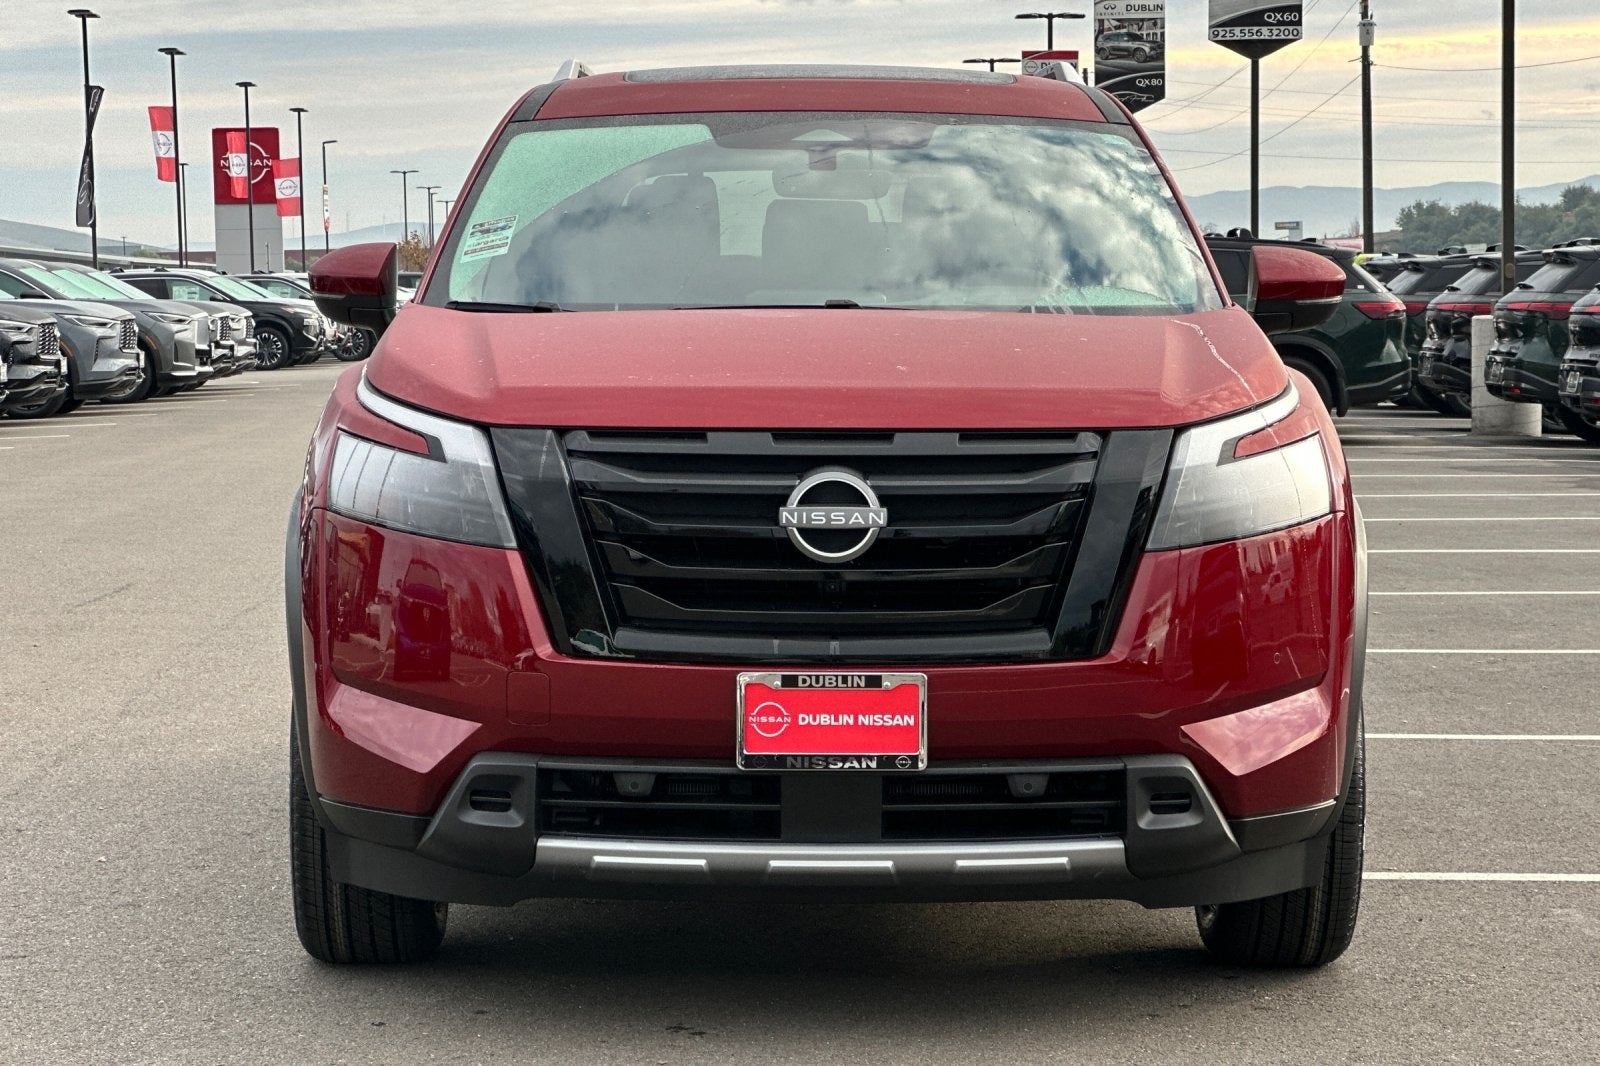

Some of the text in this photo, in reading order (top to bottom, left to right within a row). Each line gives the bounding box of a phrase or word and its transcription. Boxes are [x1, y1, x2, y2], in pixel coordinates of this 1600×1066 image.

[1126, 4, 1163, 12] DUBLIN
[1264, 12, 1299, 23] QX60
[1212, 28, 1300, 38] 925.556.3200
[1136, 78, 1163, 87] QX80
[781, 510, 885, 526] NISSAN
[797, 675, 866, 688] DUBLIN
[798, 714, 915, 726] DUBLIN NISSAN
[786, 757, 877, 769] NISSAN
